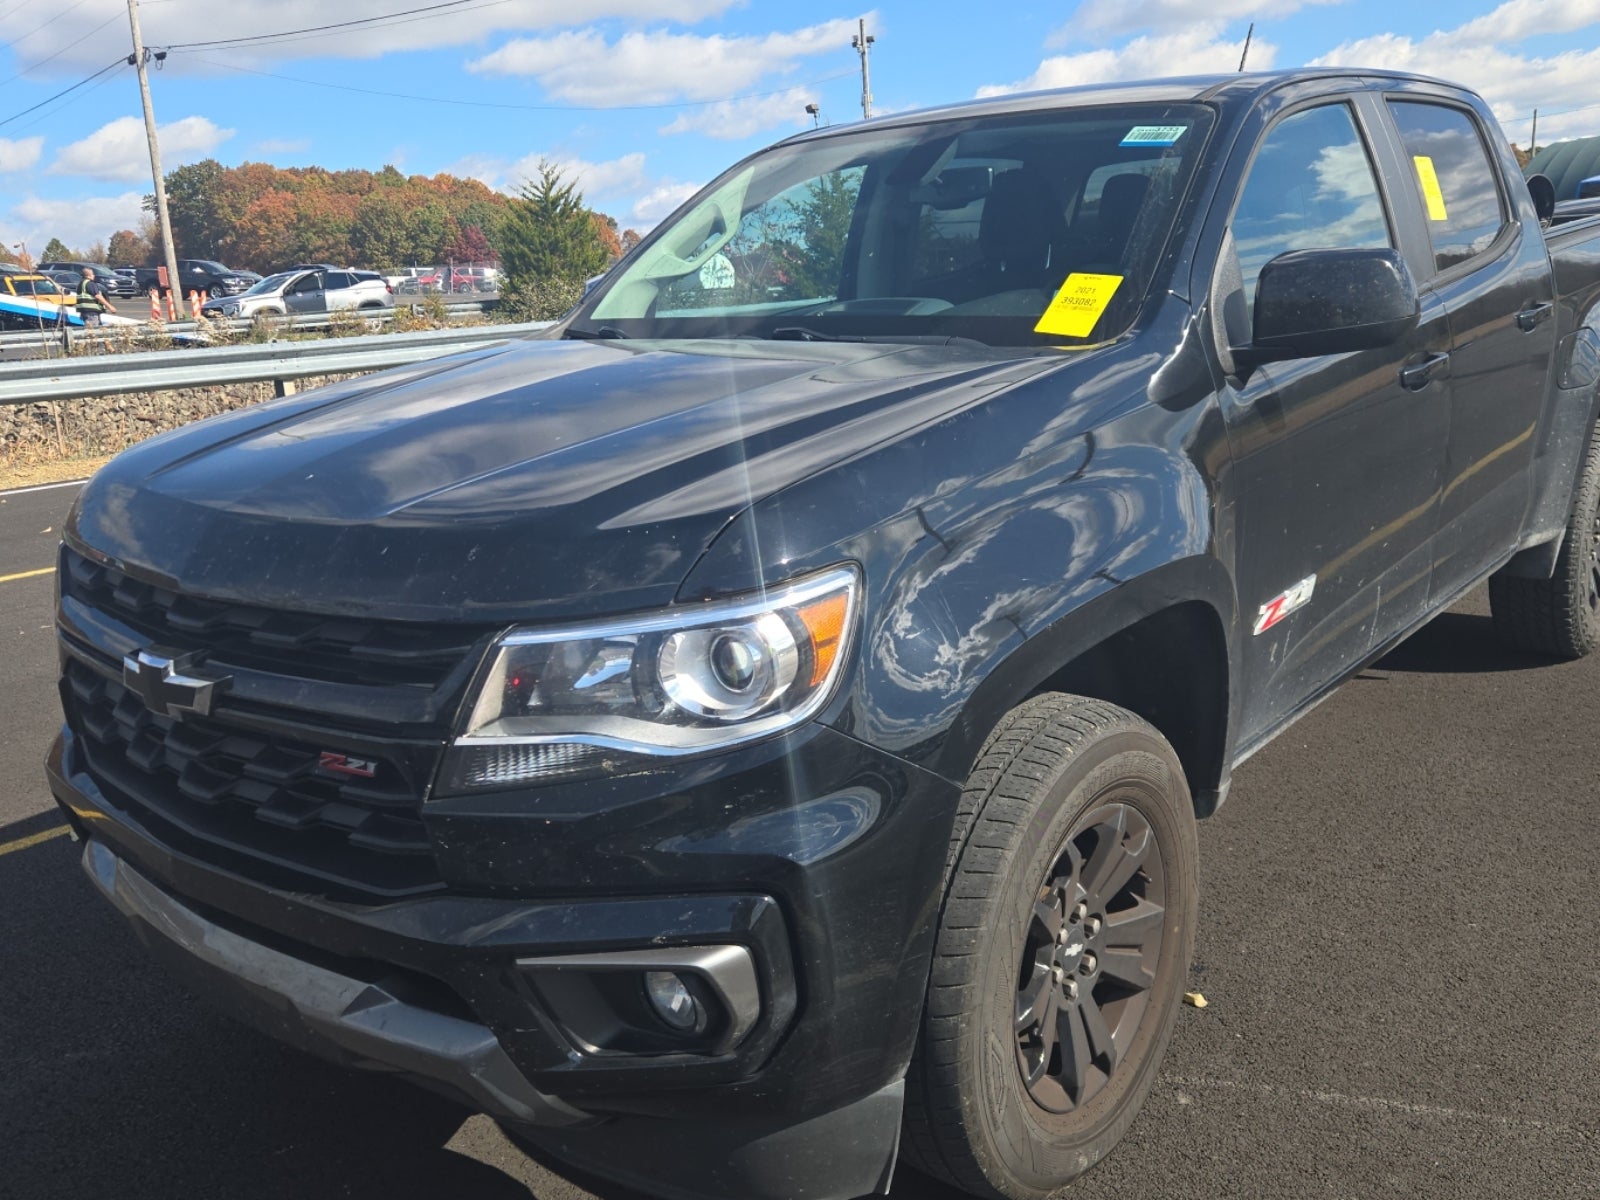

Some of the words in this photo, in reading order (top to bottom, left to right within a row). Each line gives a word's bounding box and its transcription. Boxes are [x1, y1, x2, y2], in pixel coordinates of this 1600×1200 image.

[1075, 286, 1097, 294] 2021
[1060, 296, 1097, 306] 393082
[319, 751, 378, 777] Z71
